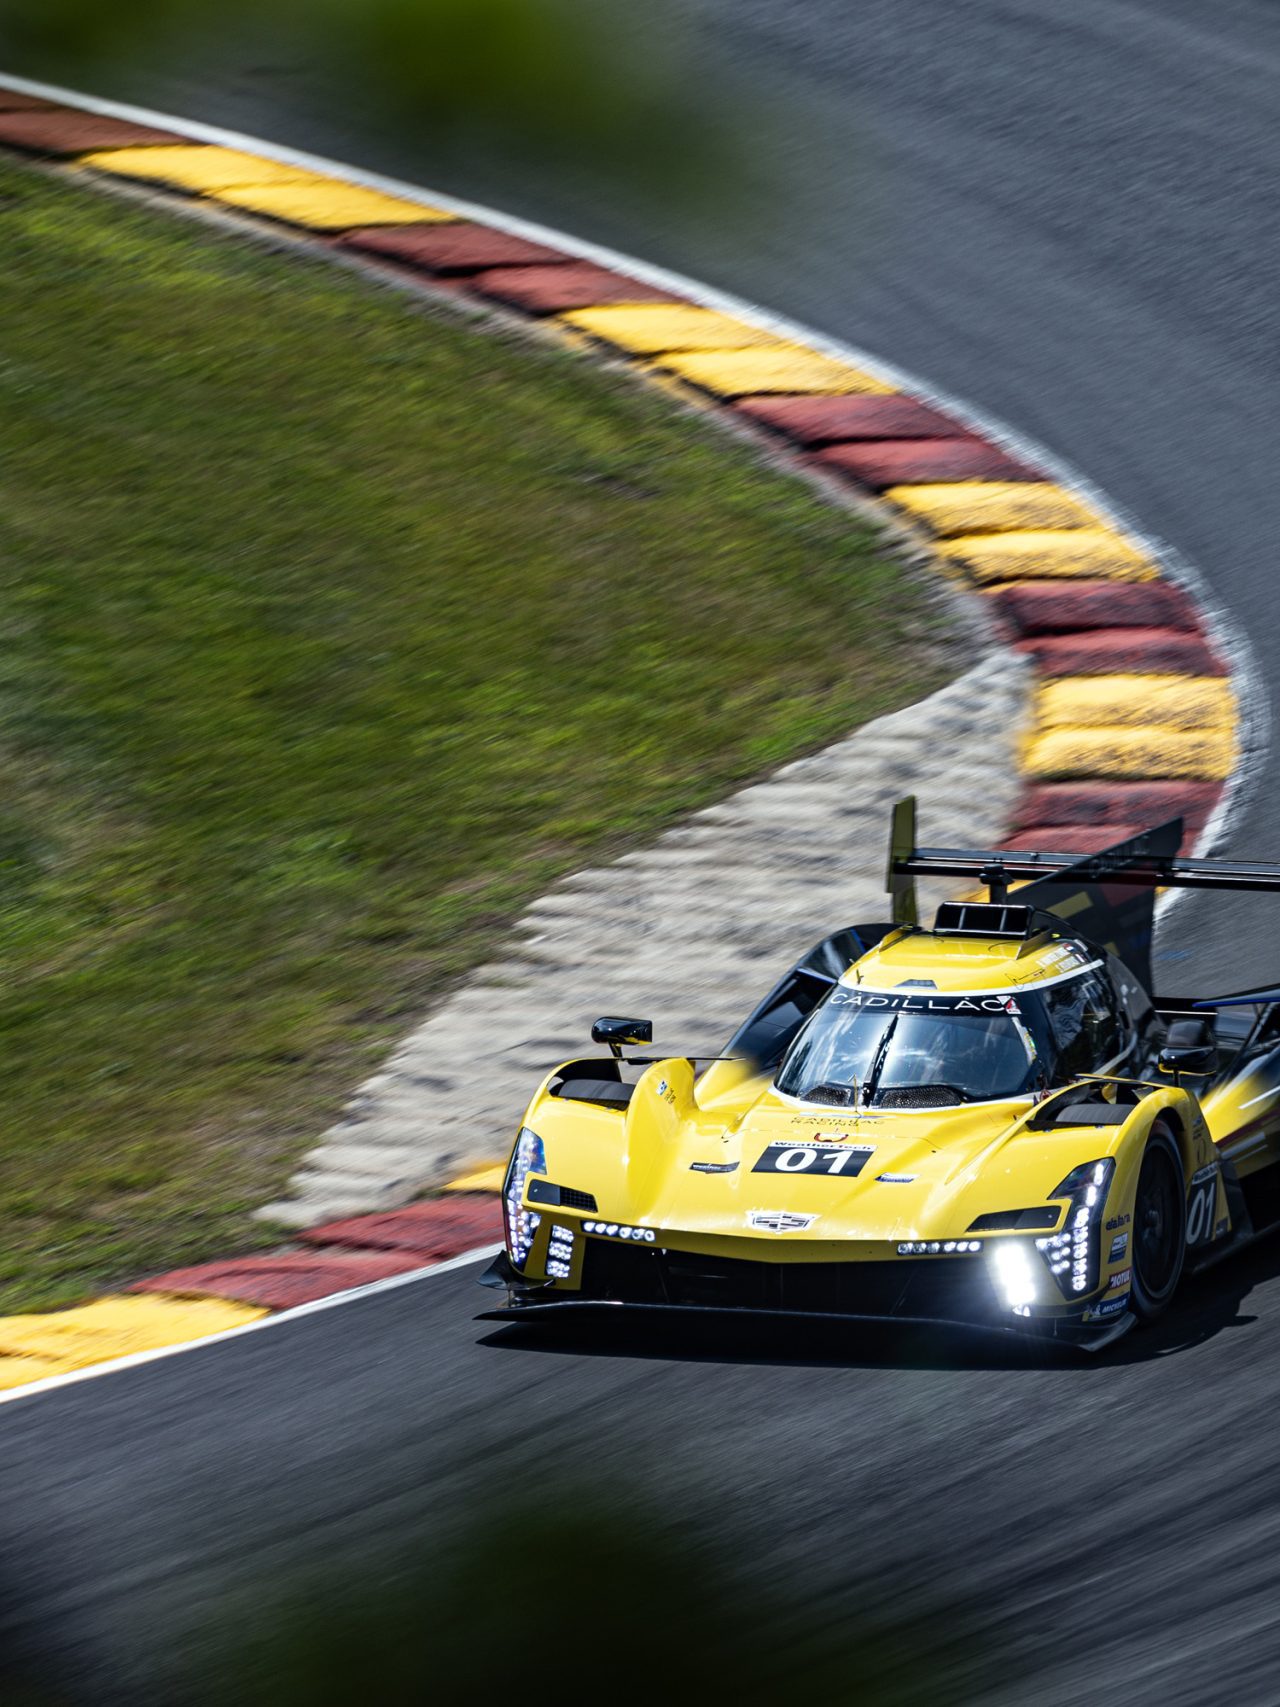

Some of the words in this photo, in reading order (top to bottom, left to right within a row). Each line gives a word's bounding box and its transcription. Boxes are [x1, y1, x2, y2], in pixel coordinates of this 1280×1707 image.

[829, 993, 1006, 1012] CADILLAC
[774, 1141, 872, 1150] WeatherTech
[774, 1148, 854, 1174] 01
[1186, 1182, 1215, 1244] 01
